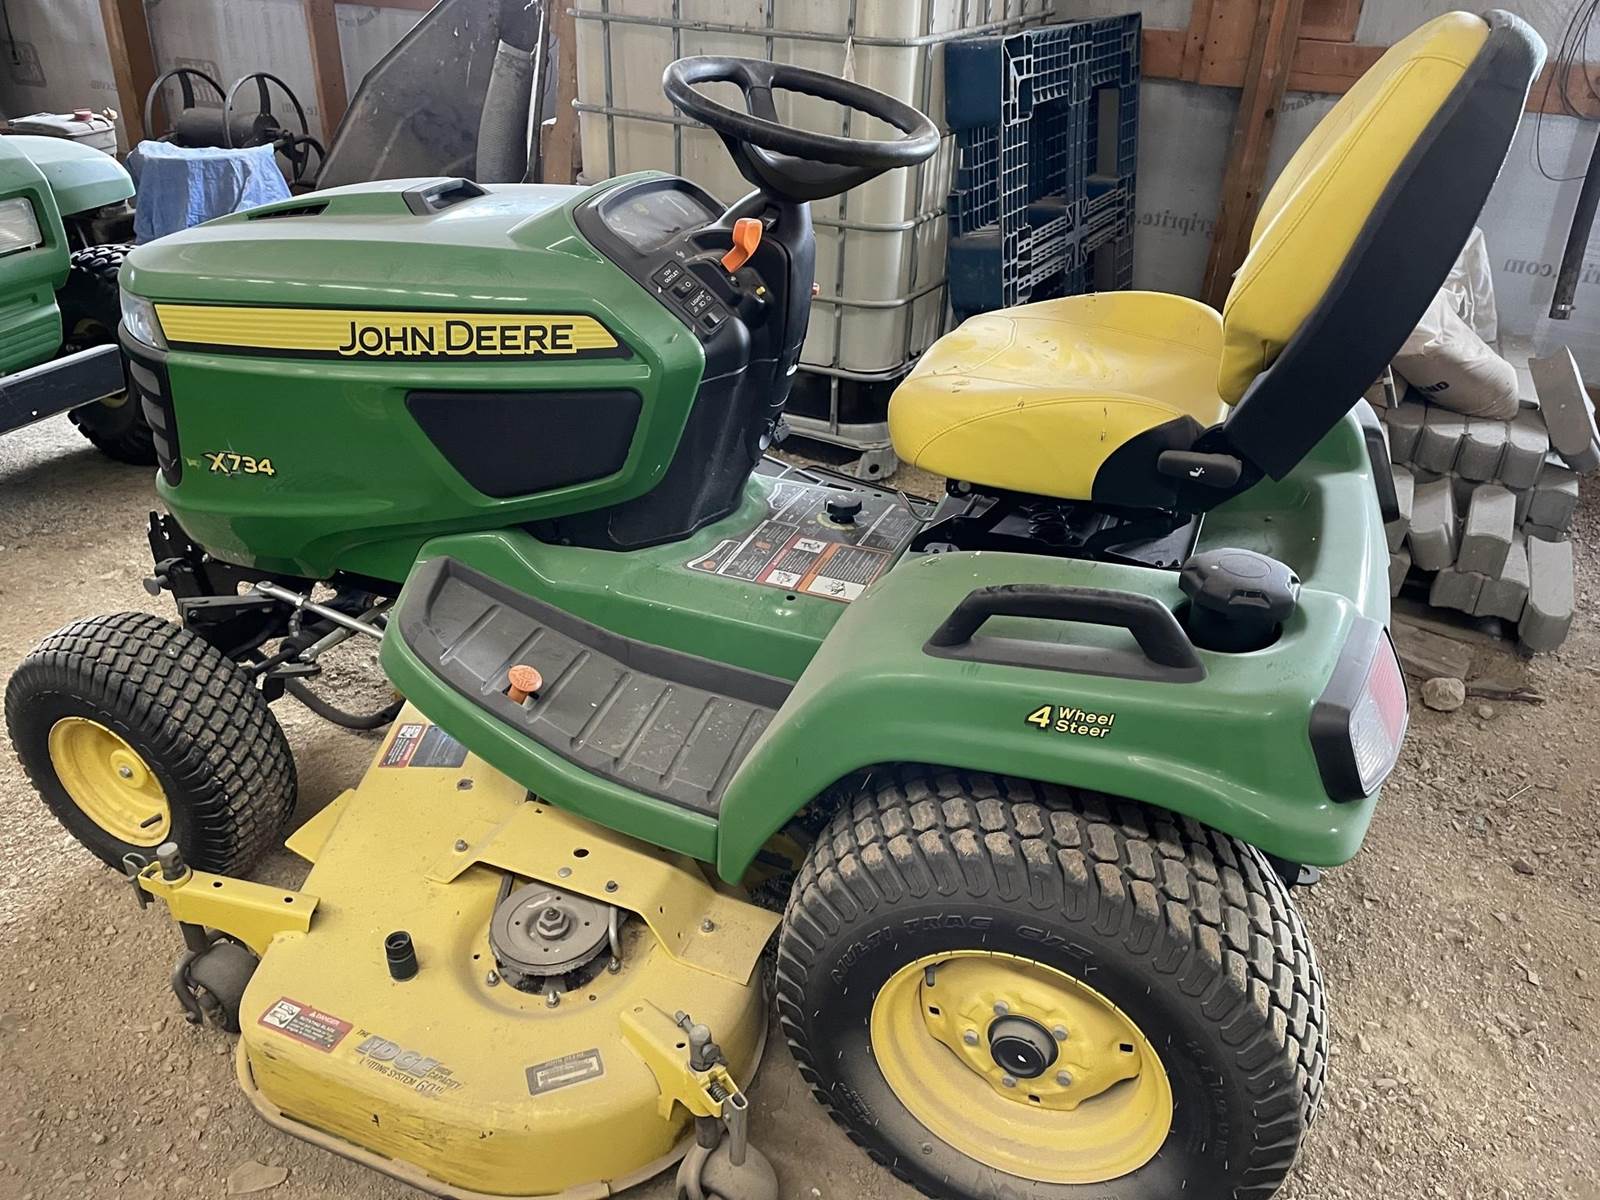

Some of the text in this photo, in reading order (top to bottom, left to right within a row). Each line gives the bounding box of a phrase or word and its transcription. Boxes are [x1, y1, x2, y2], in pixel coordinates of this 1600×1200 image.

[338, 320, 577, 355] JOHN DEERE
[203, 452, 276, 476] X734
[1027, 705, 1116, 728] 4 Wheel
[1054, 719, 1110, 738] Steer
[903, 913, 993, 936] TRAC
[387, 1069, 417, 1085] SYSTEM
